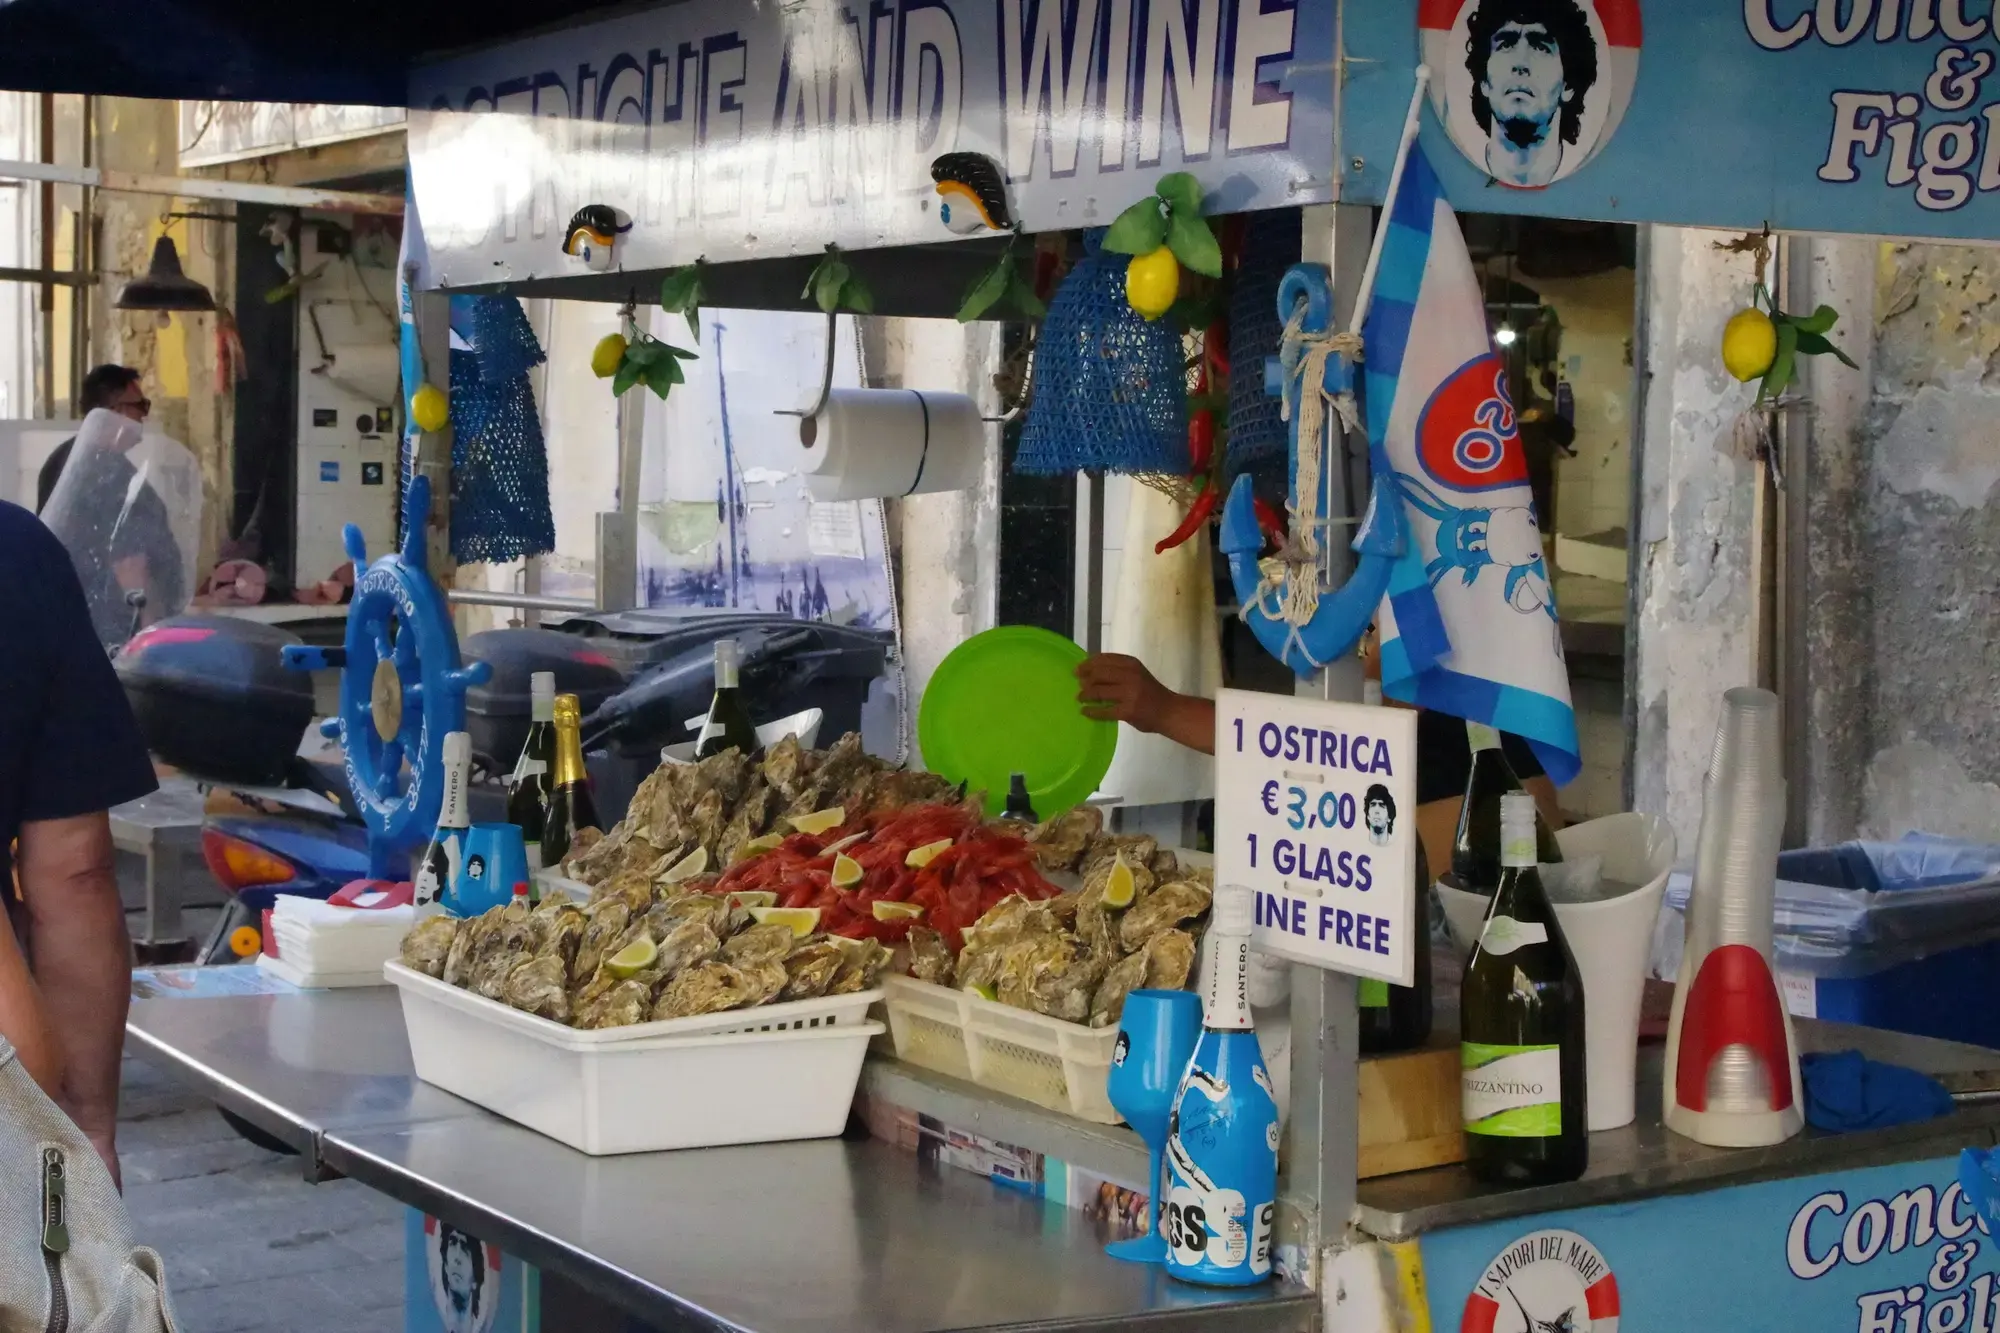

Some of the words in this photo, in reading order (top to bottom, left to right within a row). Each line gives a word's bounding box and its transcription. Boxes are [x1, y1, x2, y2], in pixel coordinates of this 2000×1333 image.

[1742, 0, 2000, 50] Conc
[1924, 46, 1996, 112] &
[430, 31, 748, 250] TRICHE
[766, 0, 964, 213] AND
[998, 0, 1296, 184] WINE
[1233, 717, 1244, 752] 1
[1259, 722, 1393, 777] OSTRICA
[448, 771, 459, 815] SANTERO
[1247, 833, 1257, 868] 1
[1273, 839, 1372, 892] GLASS
[1255, 891, 1307, 937] INE
[1319, 905, 1390, 956] FREE
[1238, 943, 1247, 1010] SANTERO
[1464, 1078, 1543, 1095] RIZZANTINO
[1786, 1180, 1990, 1280] Conc
[1486, 1240, 1536, 1290] SAPORI
[1540, 1236, 1563, 1261] DEL
[1565, 1240, 1603, 1285] MARE
[1928, 1239, 1980, 1292] &
